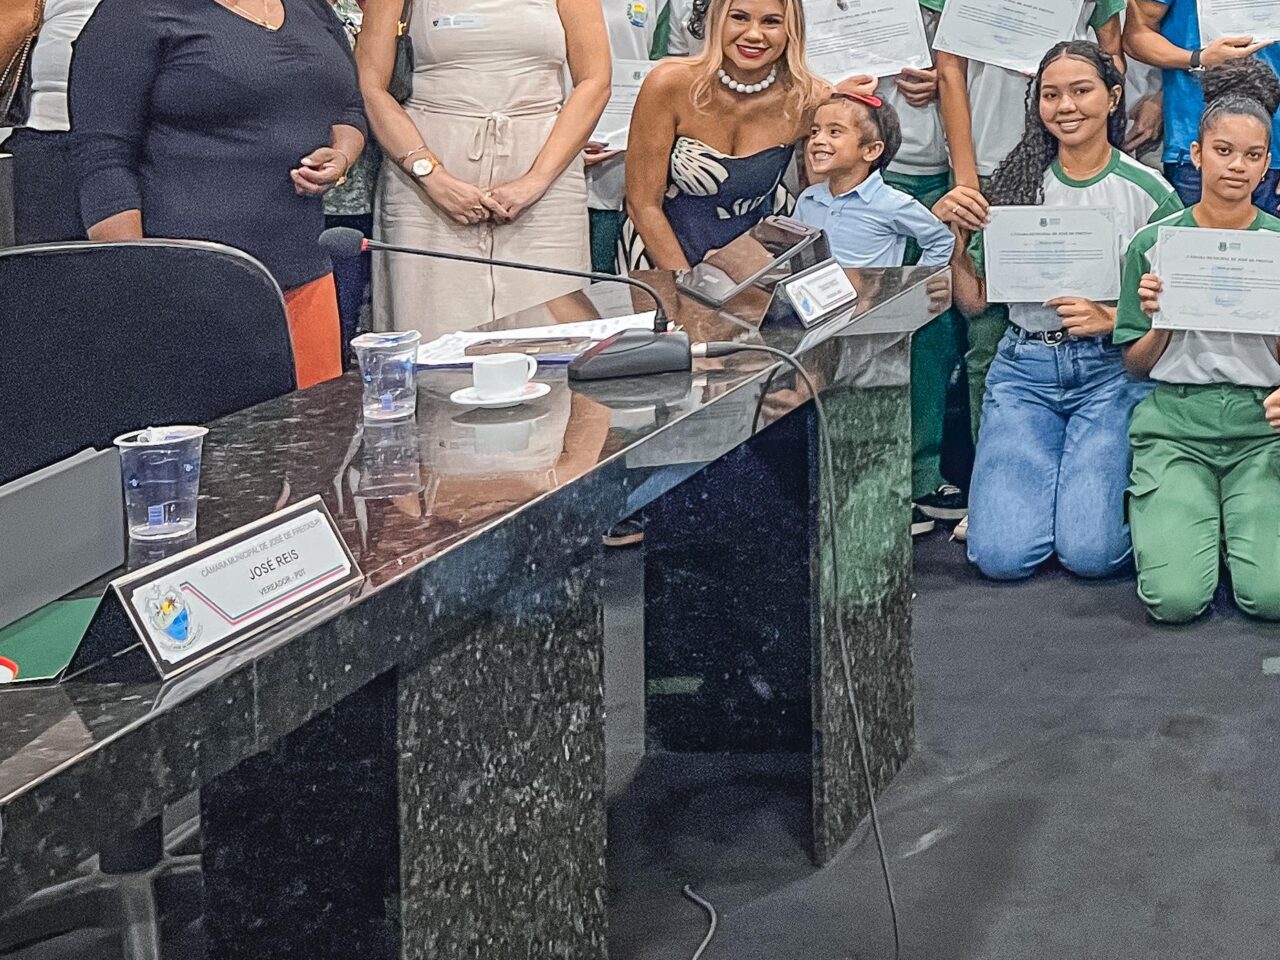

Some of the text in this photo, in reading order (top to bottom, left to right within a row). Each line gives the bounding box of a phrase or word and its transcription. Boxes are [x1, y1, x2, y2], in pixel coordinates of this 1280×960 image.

[259, 542, 269, 552] DE
[269, 535, 284, 548] JOSÉ
[284, 530, 293, 540] DE
[250, 549, 299, 580] JOSÉ REIS
[259, 574, 292, 596] VEREADOR
[295, 568, 306, 580] PDT
